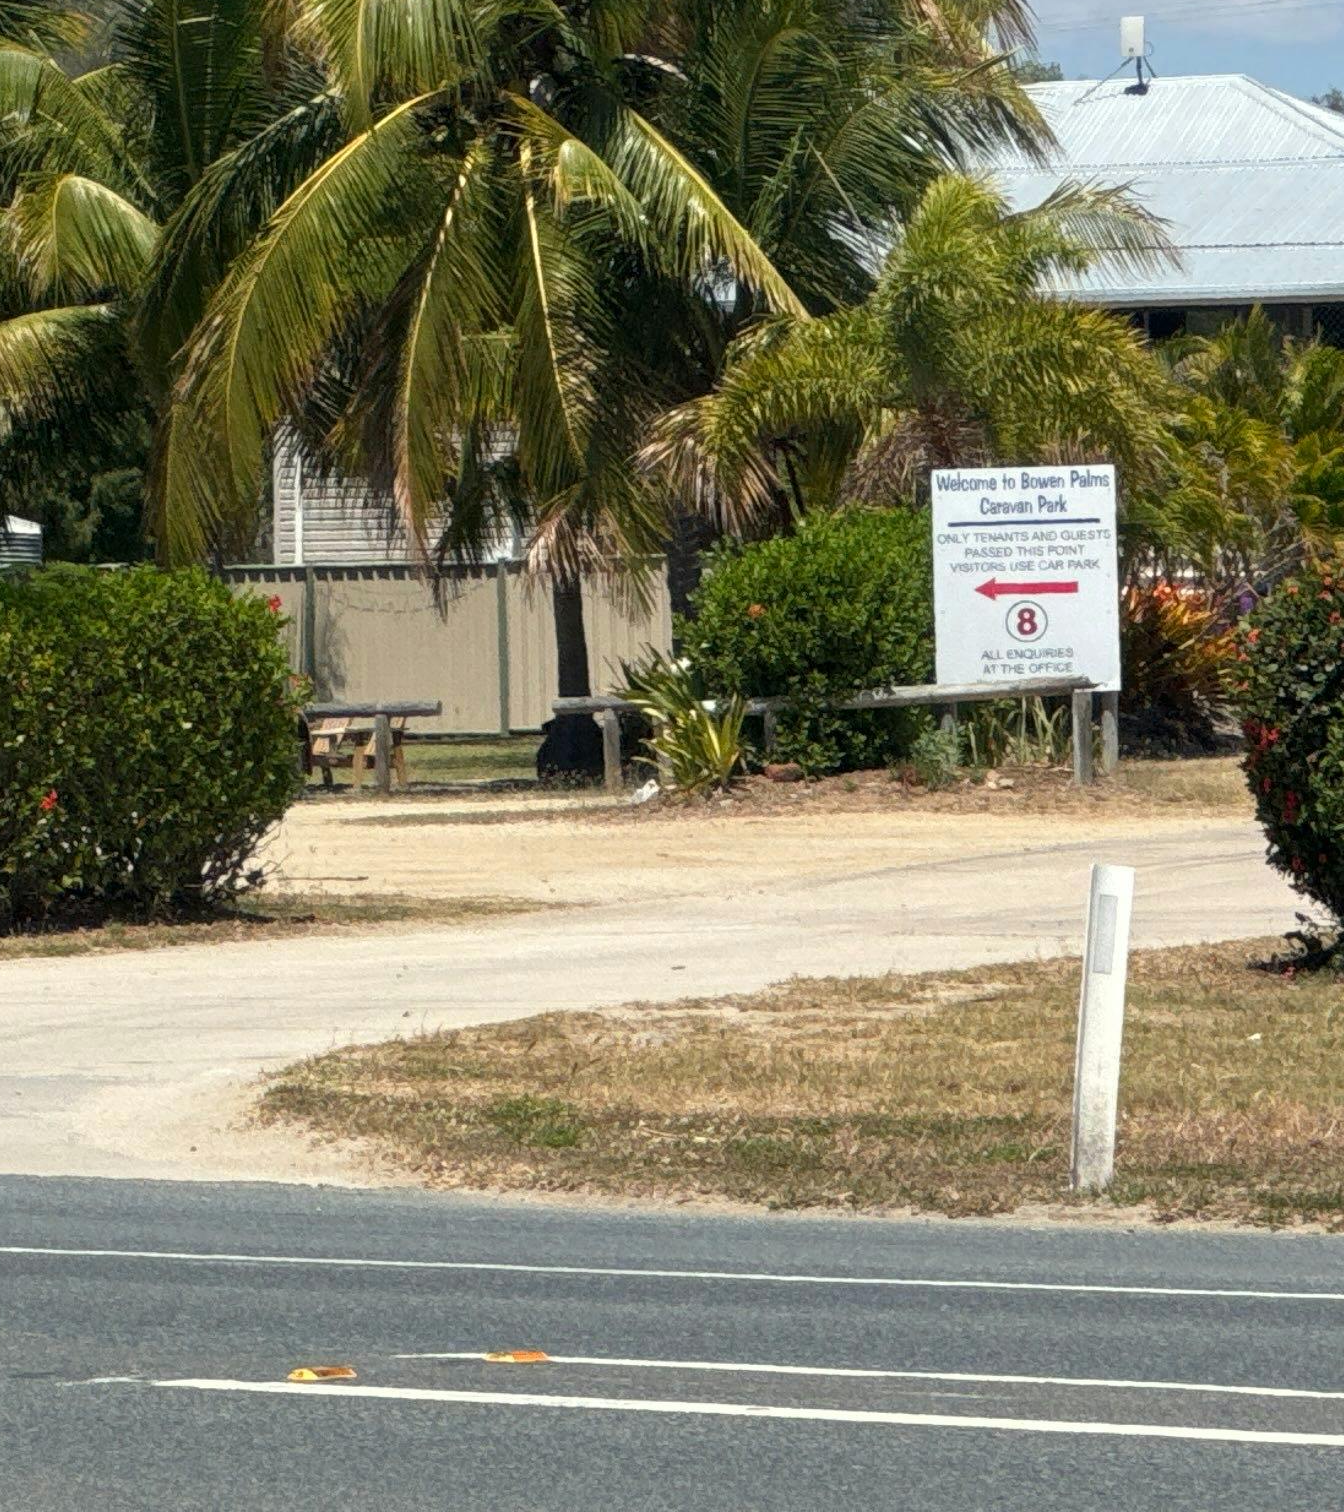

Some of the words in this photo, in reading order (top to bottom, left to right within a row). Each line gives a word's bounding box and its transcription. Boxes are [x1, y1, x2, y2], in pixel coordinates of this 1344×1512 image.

[937, 473, 997, 492] Welcome
[1002, 473, 1015, 490] to
[1021, 473, 1064, 489] Bowen
[1070, 469, 1110, 487] Palms
[980, 498, 1033, 515] Caravan
[1038, 494, 1067, 513] Park
[938, 533, 969, 544] ONLY
[974, 532, 1029, 543] TENANTS
[1031, 530, 1057, 540] AND
[1061, 529, 1111, 540] GUESTS
[965, 546, 1012, 558] PASSED
[1017, 546, 1044, 556] THIS
[1048, 545, 1085, 556] POINT
[949, 562, 1006, 573] VISITORS
[1010, 560, 1034, 571] USE
[1038, 560, 1064, 570] CAR
[1068, 559, 1100, 569] PARK
[1017, 608, 1038, 635] 8
[981, 650, 1004, 660] ALL
[1007, 648, 1073, 659] ENQUIRIES
[984, 664, 999, 674] AT
[1001, 664, 1024, 673] THE
[1029, 662, 1073, 673] OFFICE
